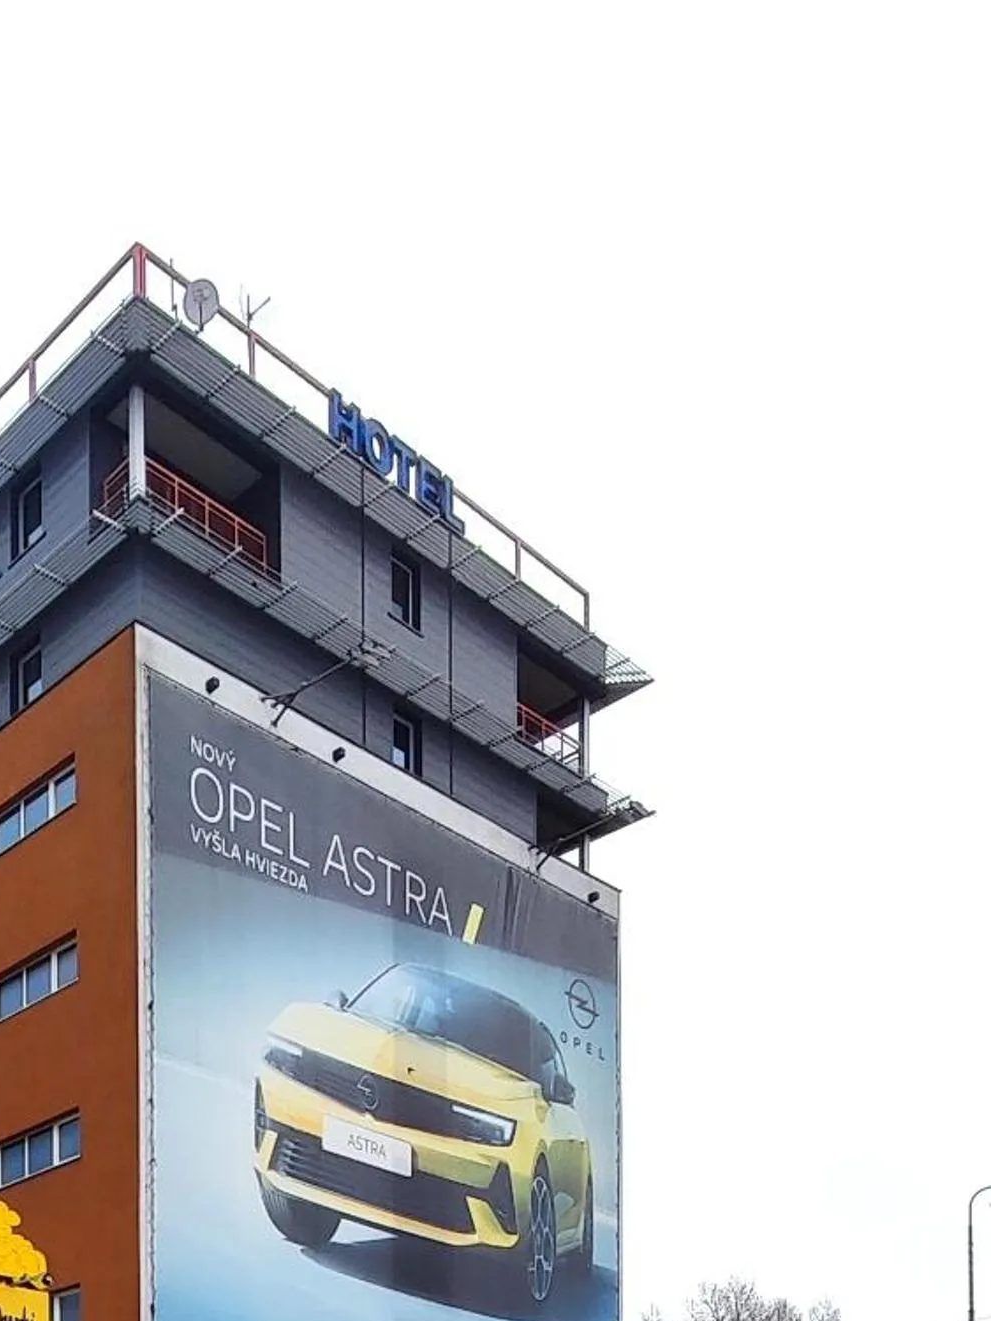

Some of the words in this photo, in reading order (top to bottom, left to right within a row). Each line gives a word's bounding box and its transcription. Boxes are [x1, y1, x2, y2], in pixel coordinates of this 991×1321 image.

[328, 387, 466, 537] HOTEL
[190, 734, 237, 772] NOVÝ
[190, 766, 310, 869] OPEL
[322, 834, 453, 937] ASTRA
[190, 823, 242, 864] VYŠLA
[245, 849, 309, 893] HVIEZDA
[560, 1031, 605, 1061] OPEL
[347, 1134, 386, 1158] ASTRA
